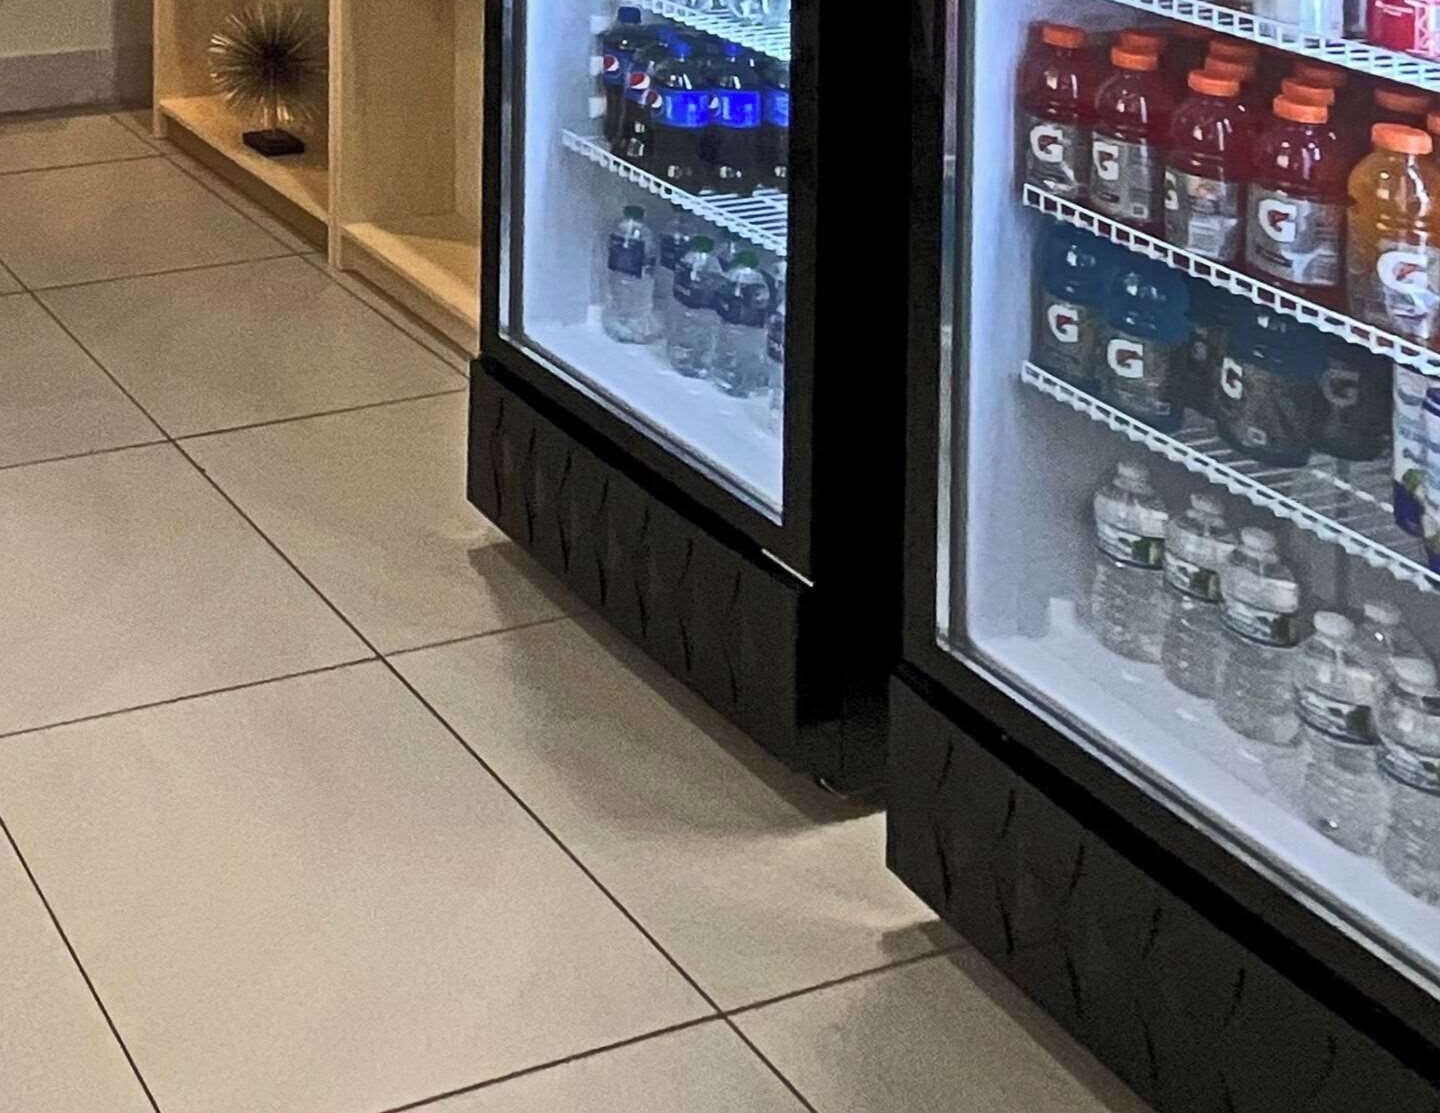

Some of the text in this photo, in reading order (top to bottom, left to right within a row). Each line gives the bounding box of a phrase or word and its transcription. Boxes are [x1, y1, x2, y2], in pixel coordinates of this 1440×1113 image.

[1258, 199, 1298, 243] G
[1376, 251, 1429, 295] G
[1047, 304, 1079, 343] G
[1107, 339, 1144, 378] G
